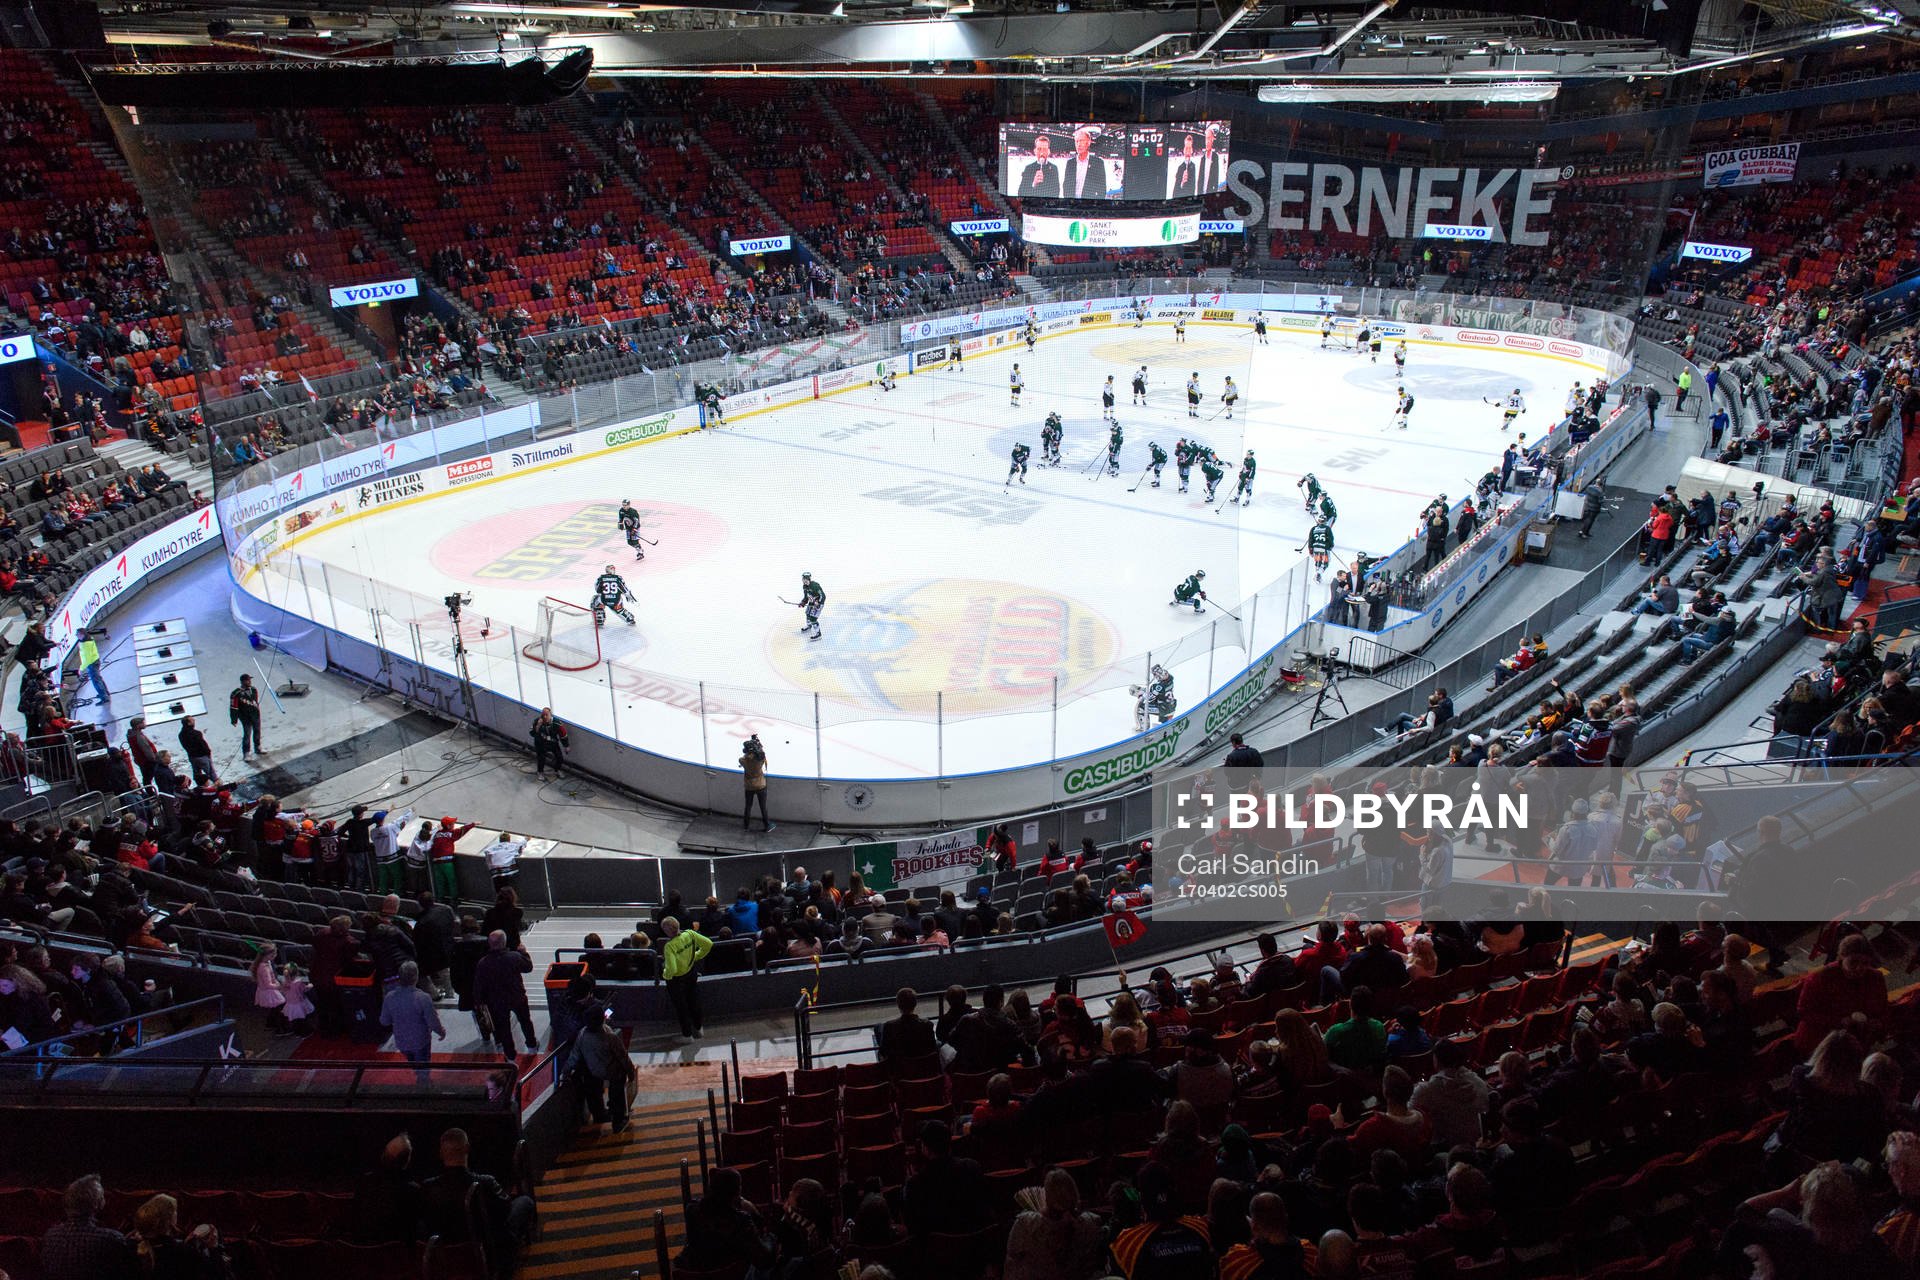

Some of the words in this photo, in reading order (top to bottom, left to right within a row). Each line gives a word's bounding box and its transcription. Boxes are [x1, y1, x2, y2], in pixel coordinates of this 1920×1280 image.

[1132, 133, 1164, 143] 04:07
[1144, 147, 1150, 157] 1
[1708, 152, 1736, 169] GOA
[1739, 144, 1797, 161] GUBBAR
[960, 221, 1002, 231] VOLVO
[1199, 222, 1235, 231] OLVO
[1436, 227, 1486, 238] VOLVO
[739, 238, 783, 252] VOLVO
[1693, 245, 1742, 259] VOLVO
[344, 283, 406, 301] VOLVO
[935, 326, 958, 336] KUMHO
[960, 322, 974, 332] TYRE
[989, 317, 1012, 327] KUMHO
[1460, 333, 1496, 343] Nintendo
[1507, 338, 1541, 349] Nintendo
[1551, 344, 1581, 355] Nintendo
[606, 420, 669, 447] CASHBUDDY
[524, 442, 574, 465] Tillmobil
[449, 458, 492, 478] Miele
[322, 466, 362, 489] KUMHO
[373, 472, 422, 491] MILITARY
[449, 470, 494, 487] PROFESSIONAL
[375, 482, 425, 504] FITNESS
[230, 500, 270, 525] KUMHO
[271, 488, 296, 507] TYRE
[141, 541, 178, 572] KUMHO
[180, 527, 204, 552] TYRE
[602, 582, 618, 594] 39
[79, 594, 101, 625] KUMHO
[100, 575, 124, 601] TYRE
[1205, 671, 1267, 733] CASHBUDDY
[1065, 735, 1179, 793] CASHBUDDY
[892, 846, 984, 883] ROOKIES
